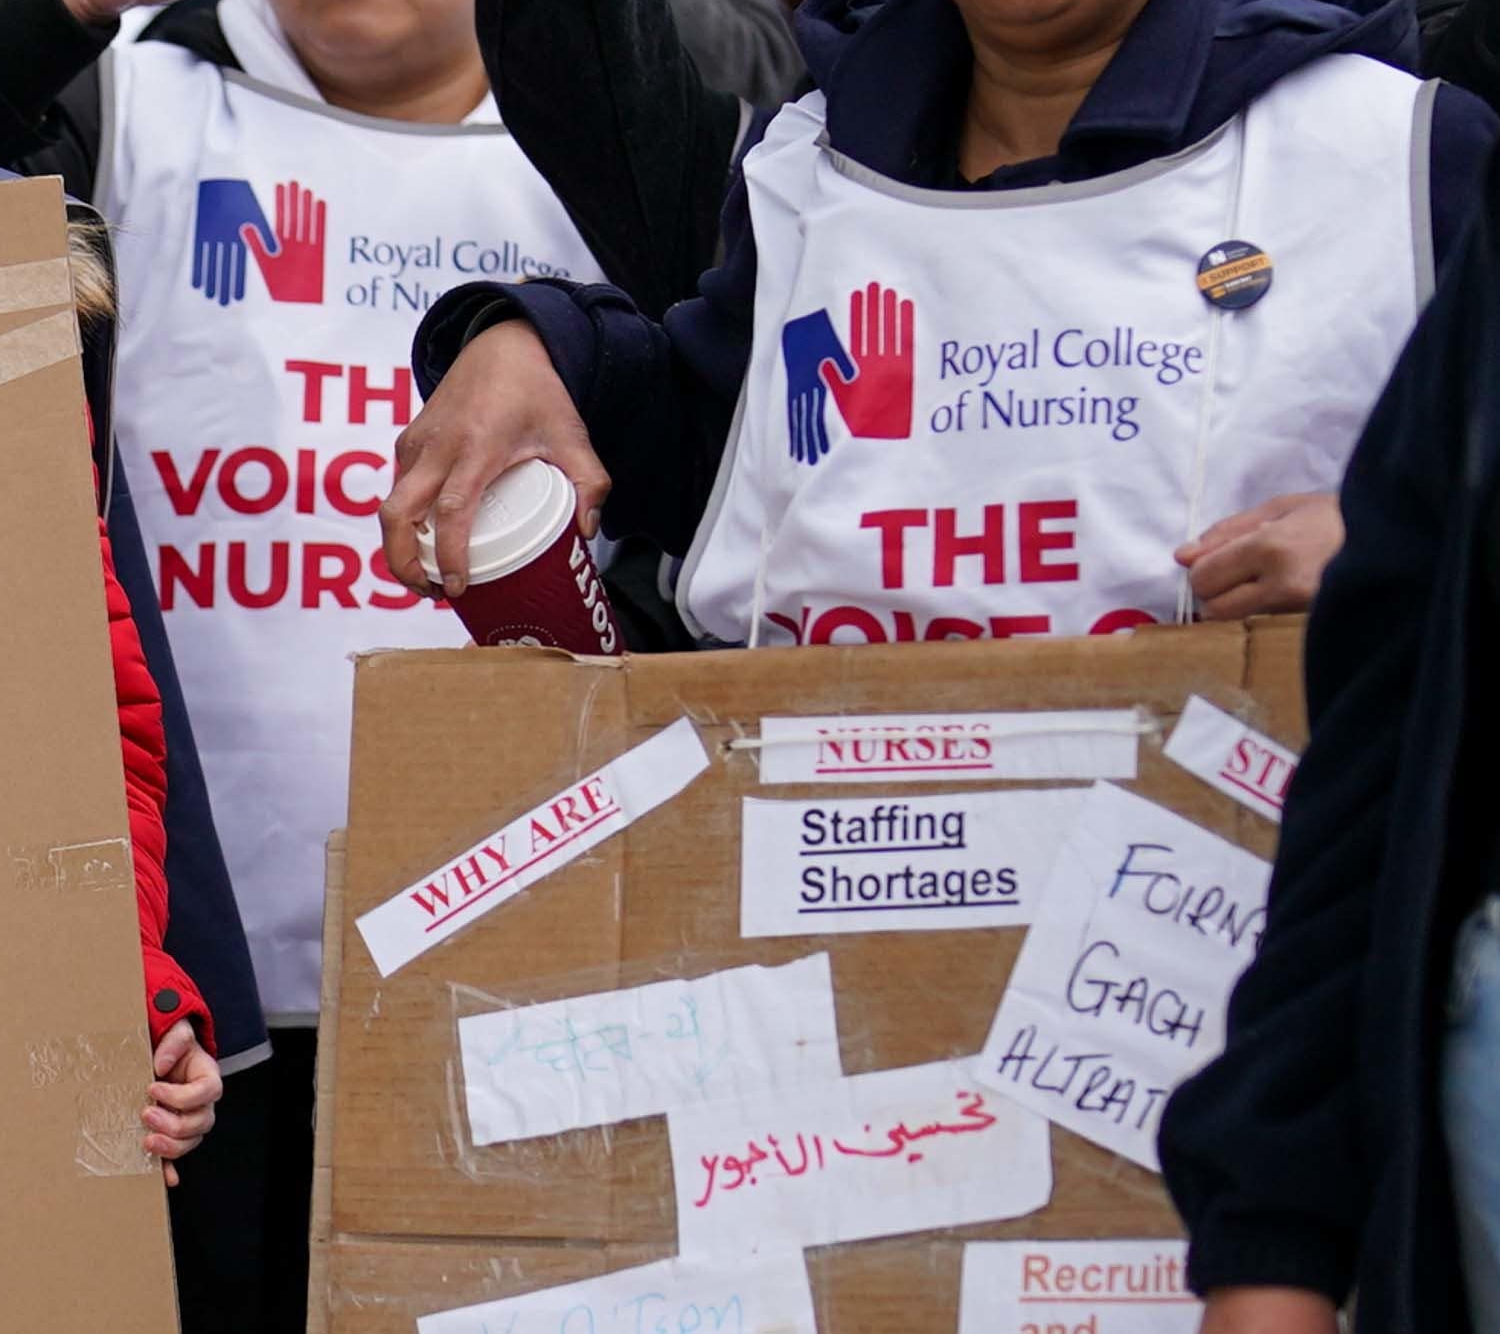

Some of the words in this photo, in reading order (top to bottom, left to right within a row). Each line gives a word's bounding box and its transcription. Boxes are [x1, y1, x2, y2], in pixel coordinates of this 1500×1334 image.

[350, 235, 441, 278] Royal
[345, 274, 384, 308] of
[939, 329, 1040, 385] Royal
[1053, 327, 1203, 385] College
[285, 359, 413, 426] TH
[930, 389, 973, 434] of
[982, 387, 1140, 442] Nursing
[151, 446, 402, 518] VOIC
[860, 499, 1080, 590] THE
[159, 540, 440, 613] NURS
[568, 534, 617, 654] COSTA
[815, 723, 993, 765] NURSES
[410, 835, 513, 918] WHY
[528, 775, 615, 855] ARE
[800, 805, 966, 848] Staffing
[800, 866, 1018, 906] Shortages
[1021, 1253, 1190, 1294] Recruit
